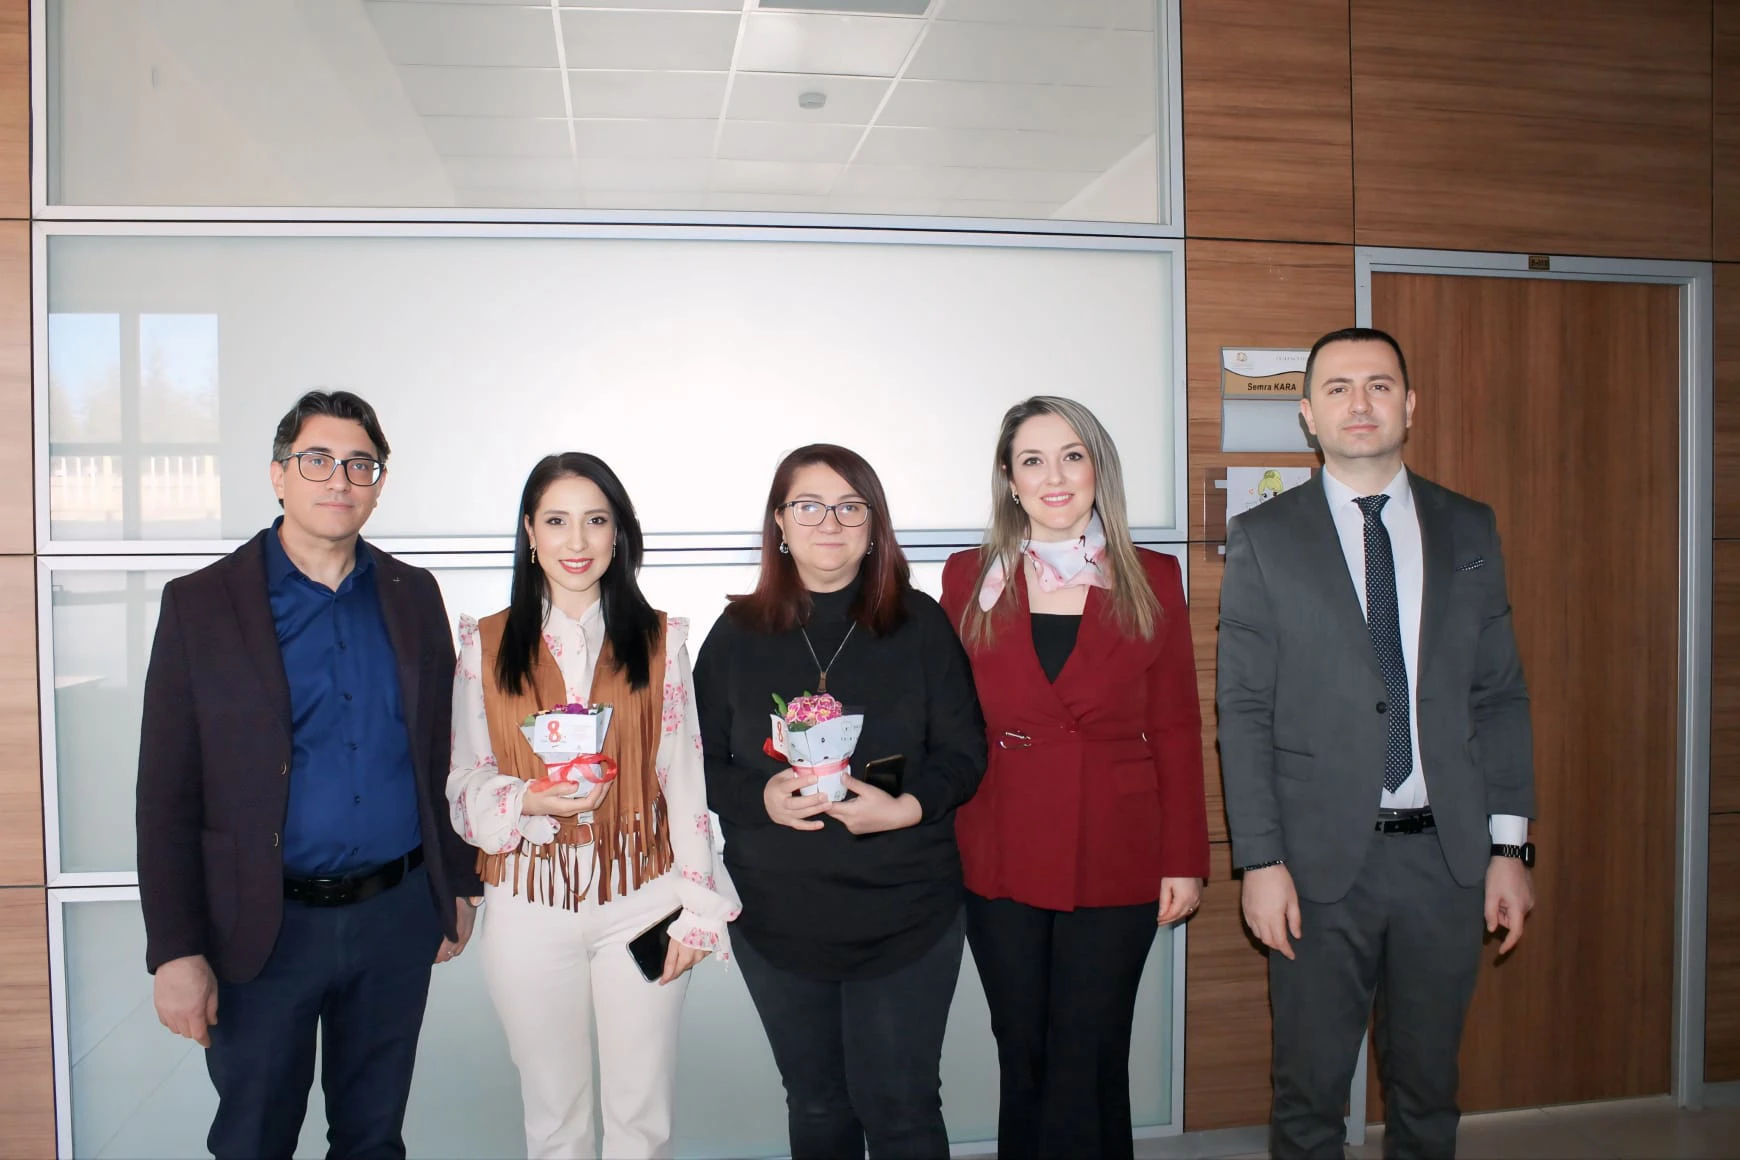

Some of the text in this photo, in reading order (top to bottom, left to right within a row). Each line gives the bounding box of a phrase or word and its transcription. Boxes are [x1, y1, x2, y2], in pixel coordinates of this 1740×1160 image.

[1247, 382, 1296, 391] Semra KARA
[547, 720, 560, 742] 8
